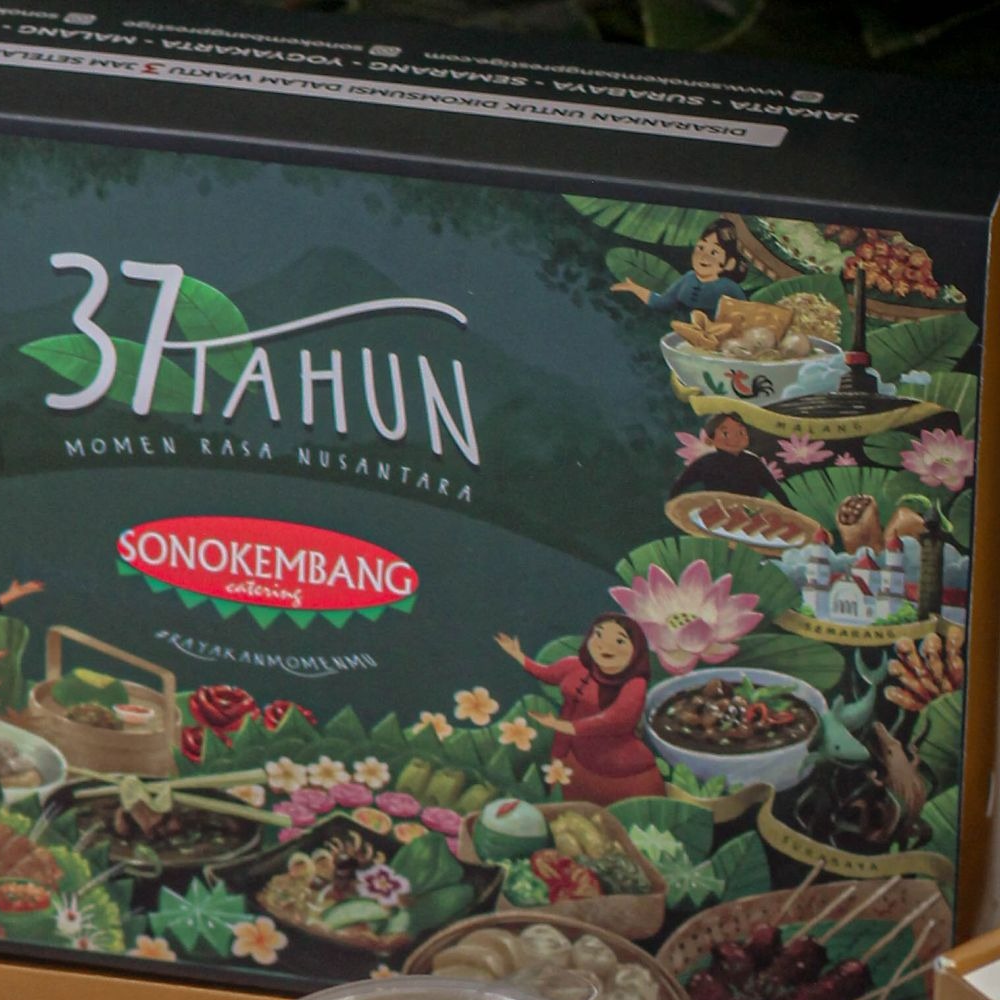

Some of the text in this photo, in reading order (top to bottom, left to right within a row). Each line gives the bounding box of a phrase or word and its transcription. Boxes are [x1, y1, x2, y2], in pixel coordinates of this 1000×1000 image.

[18, 22, 138, 46] MALANG
[88, 58, 137, 73] JAM
[162, 39, 344, 67] YOGYAKARTA
[141, 61, 161, 75] 3
[168, 66, 252, 84] WAKTU
[370, 61, 526, 86] SEMARANG
[258, 71, 343, 93] DALAM
[552, 80, 705, 106] SURABAYA
[504, 101, 585, 121] UNTUK
[730, 99, 859, 124] JAKARTA
[591, 112, 747, 138] DISARANKAN
[45, 252, 481, 467] 37 TAHUN
[775, 420, 864, 434] MALANG
[64, 436, 473, 502] MOMEN RASA NUSANTARA
[117, 528, 414, 597] SONOKEMBANG
[224, 580, 303, 608] catering
